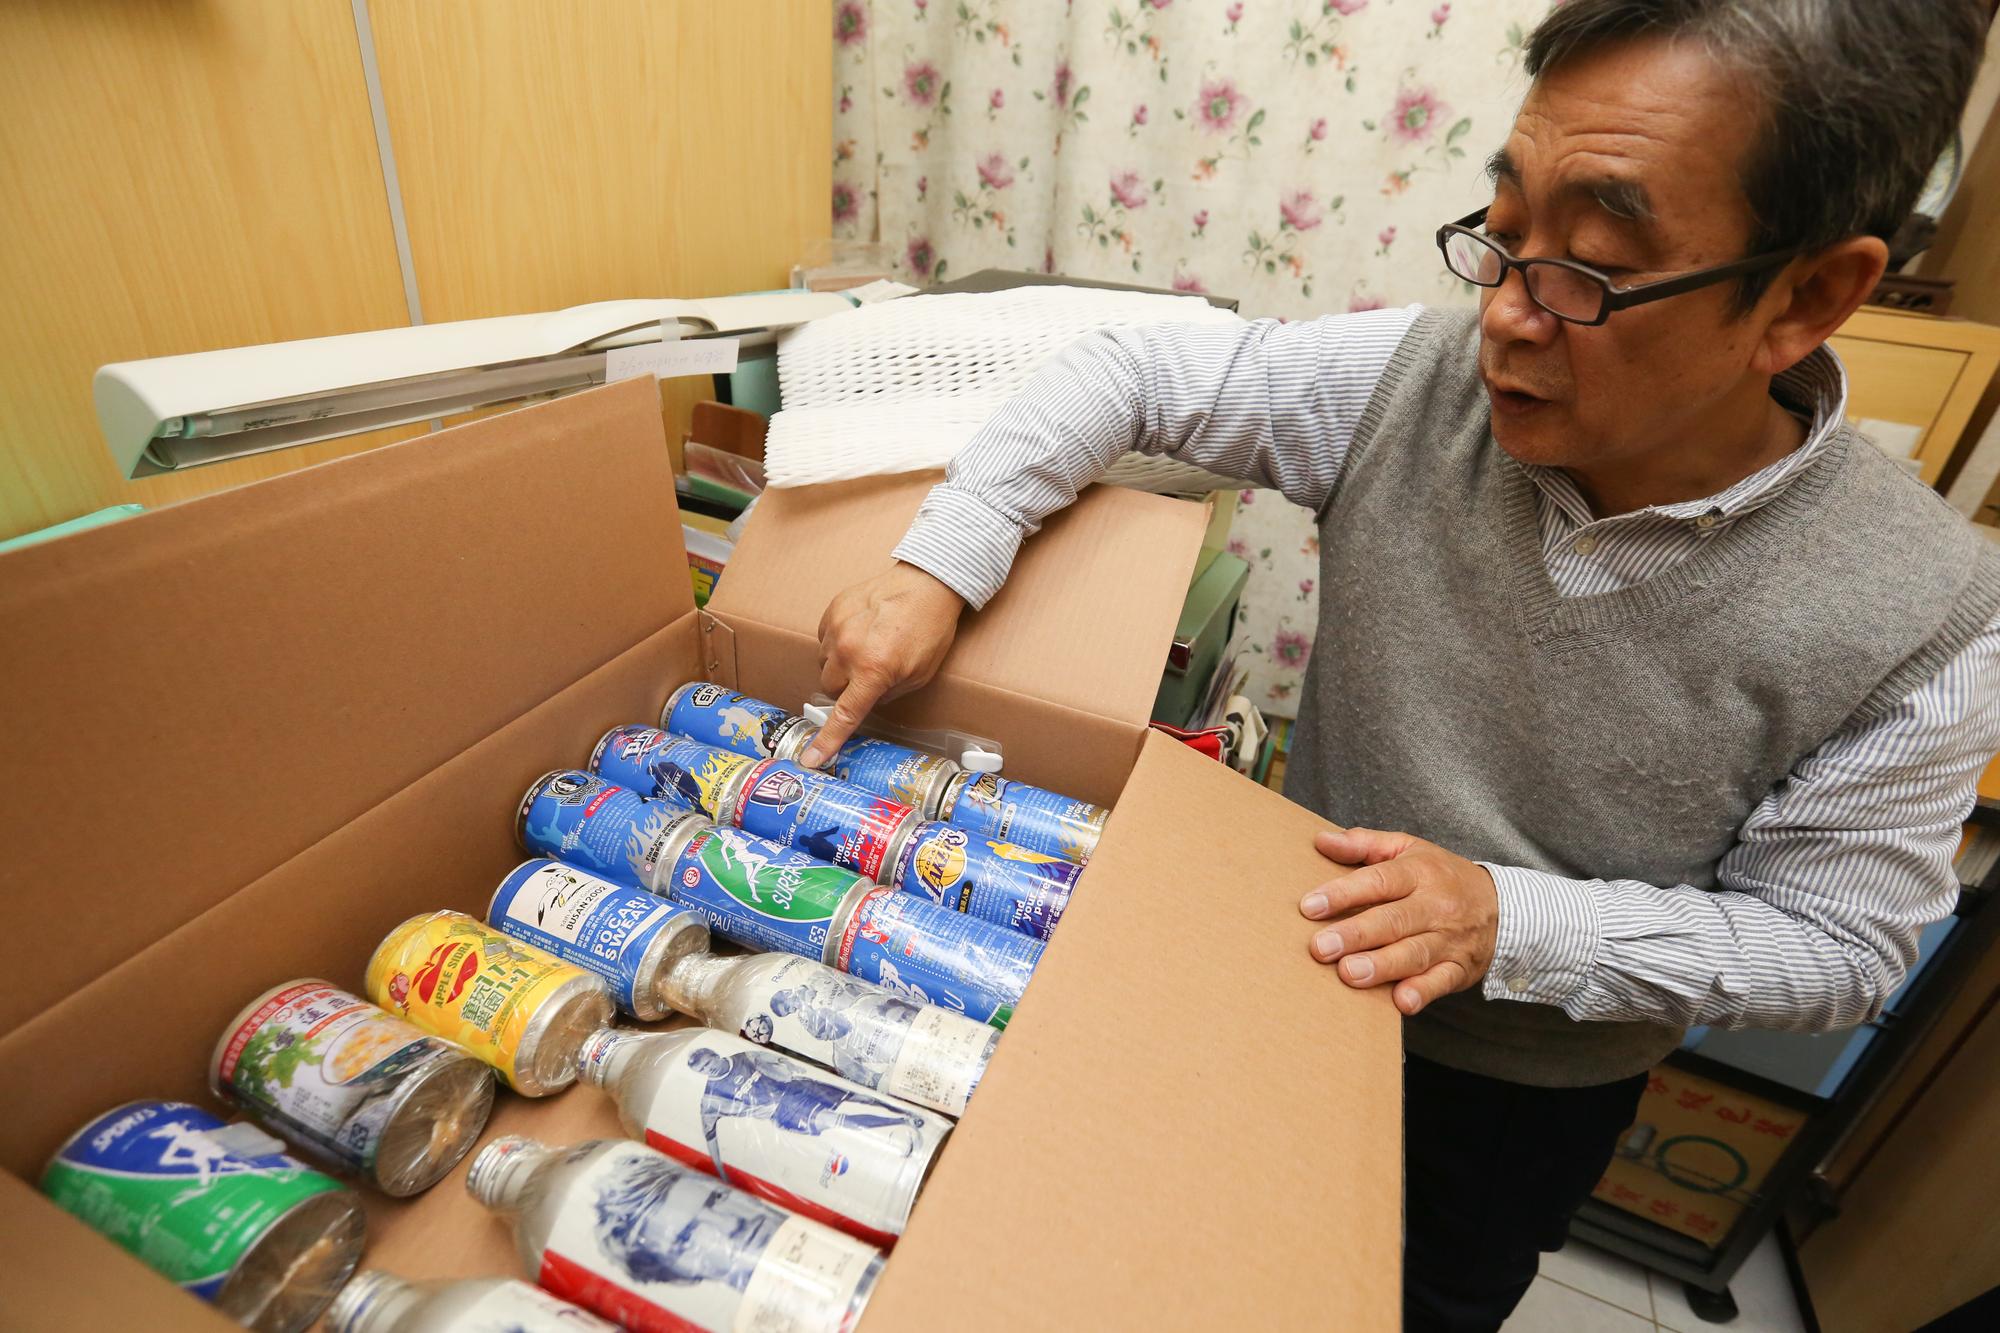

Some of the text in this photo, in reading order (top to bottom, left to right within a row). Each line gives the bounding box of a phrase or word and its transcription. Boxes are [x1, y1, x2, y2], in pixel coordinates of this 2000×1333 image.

[759, 770, 793, 802] NETS
[573, 818, 586, 847] power
[841, 836, 856, 865] your
[852, 822, 872, 860] power
[832, 843, 844, 867] Find
[922, 829, 968, 903] LAKERS
[772, 865, 805, 910] SUPER
[1022, 891, 1037, 922] your
[1034, 881, 1051, 916] powe
[566, 903, 589, 931] BUSAN
[587, 885, 608, 904] 2002
[593, 896, 647, 957] POCARI
[1011, 899, 1026, 927] Find
[604, 904, 653, 961] SWEAT
[434, 942, 474, 1009] APPLE SIDRA
[92, 1108, 158, 1153] SPORTS
